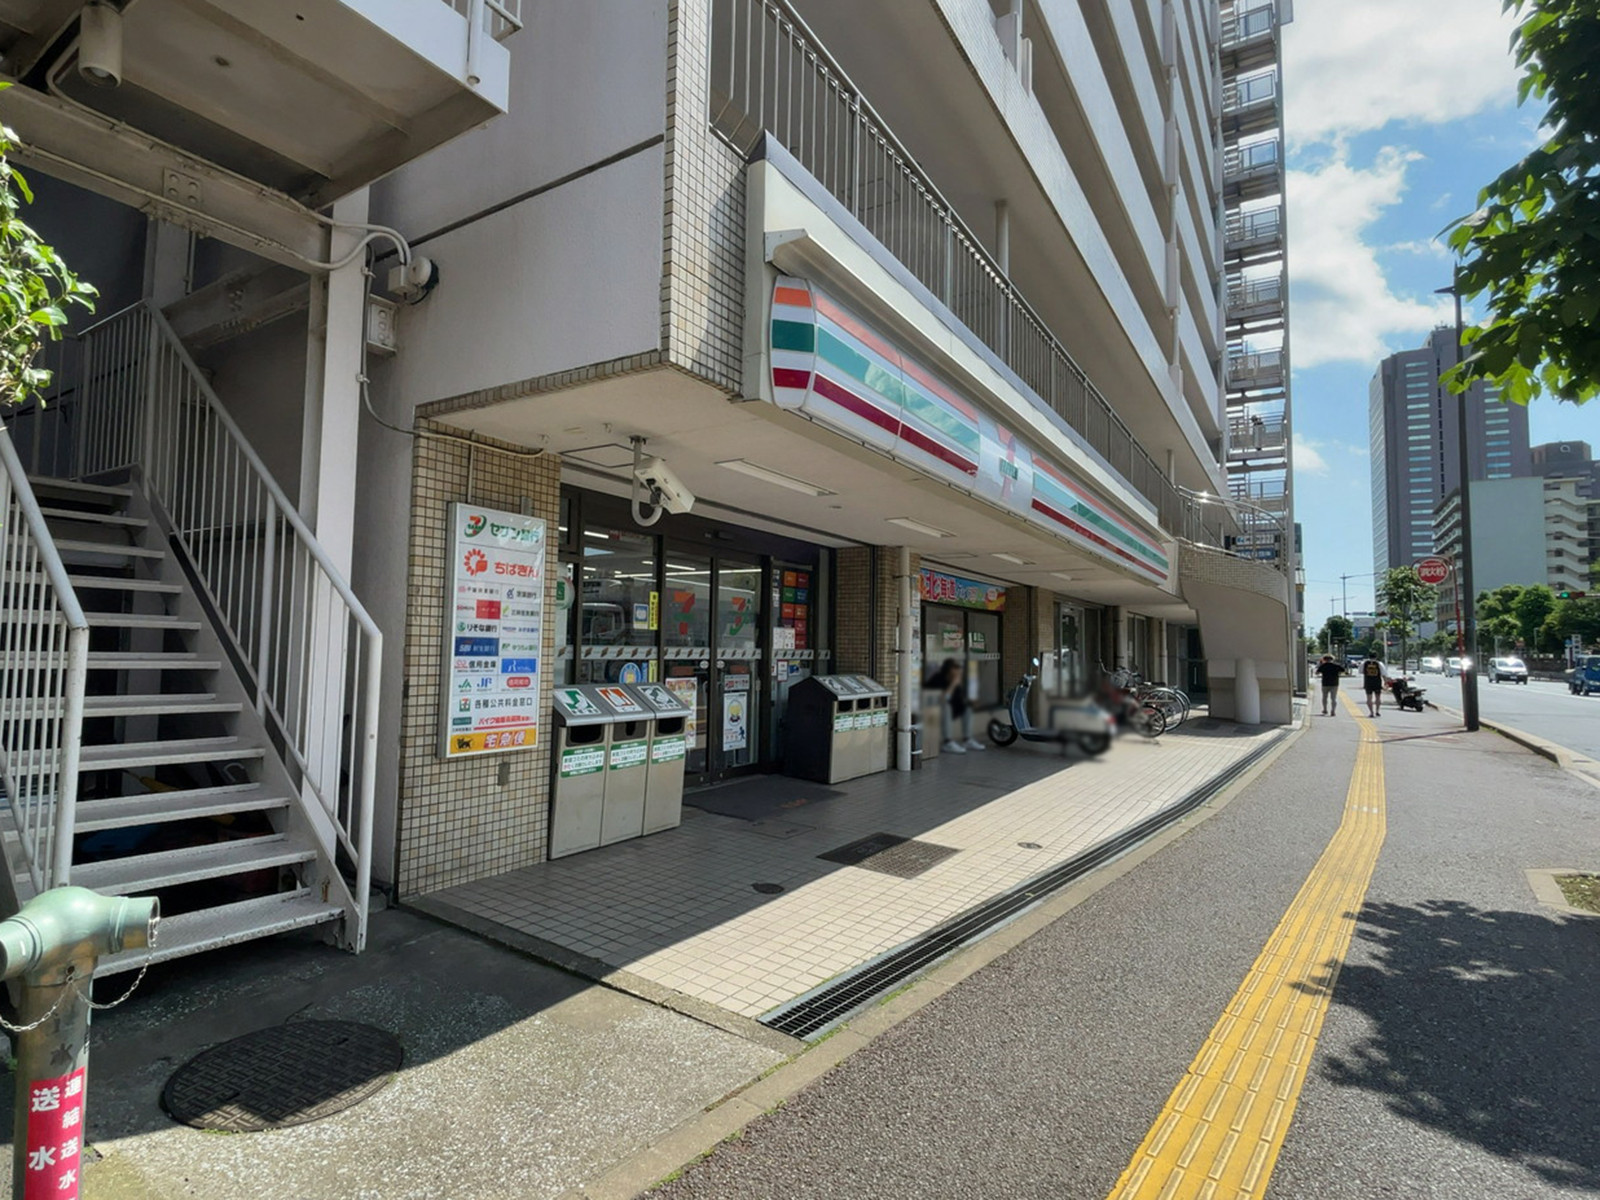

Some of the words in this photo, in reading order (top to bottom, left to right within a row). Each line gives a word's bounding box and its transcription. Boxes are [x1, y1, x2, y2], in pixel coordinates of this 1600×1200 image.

[494, 562, 539, 578] ちばぎん
[466, 623, 498, 633] りそな銀行
[469, 660, 497, 668] 信用金庫
[475, 697, 533, 709] 各種公共料金窓口
[484, 731, 527, 749] 宅急便
[28, 1086, 61, 1171] 送水
[58, 1075, 83, 1200] 連結送水
